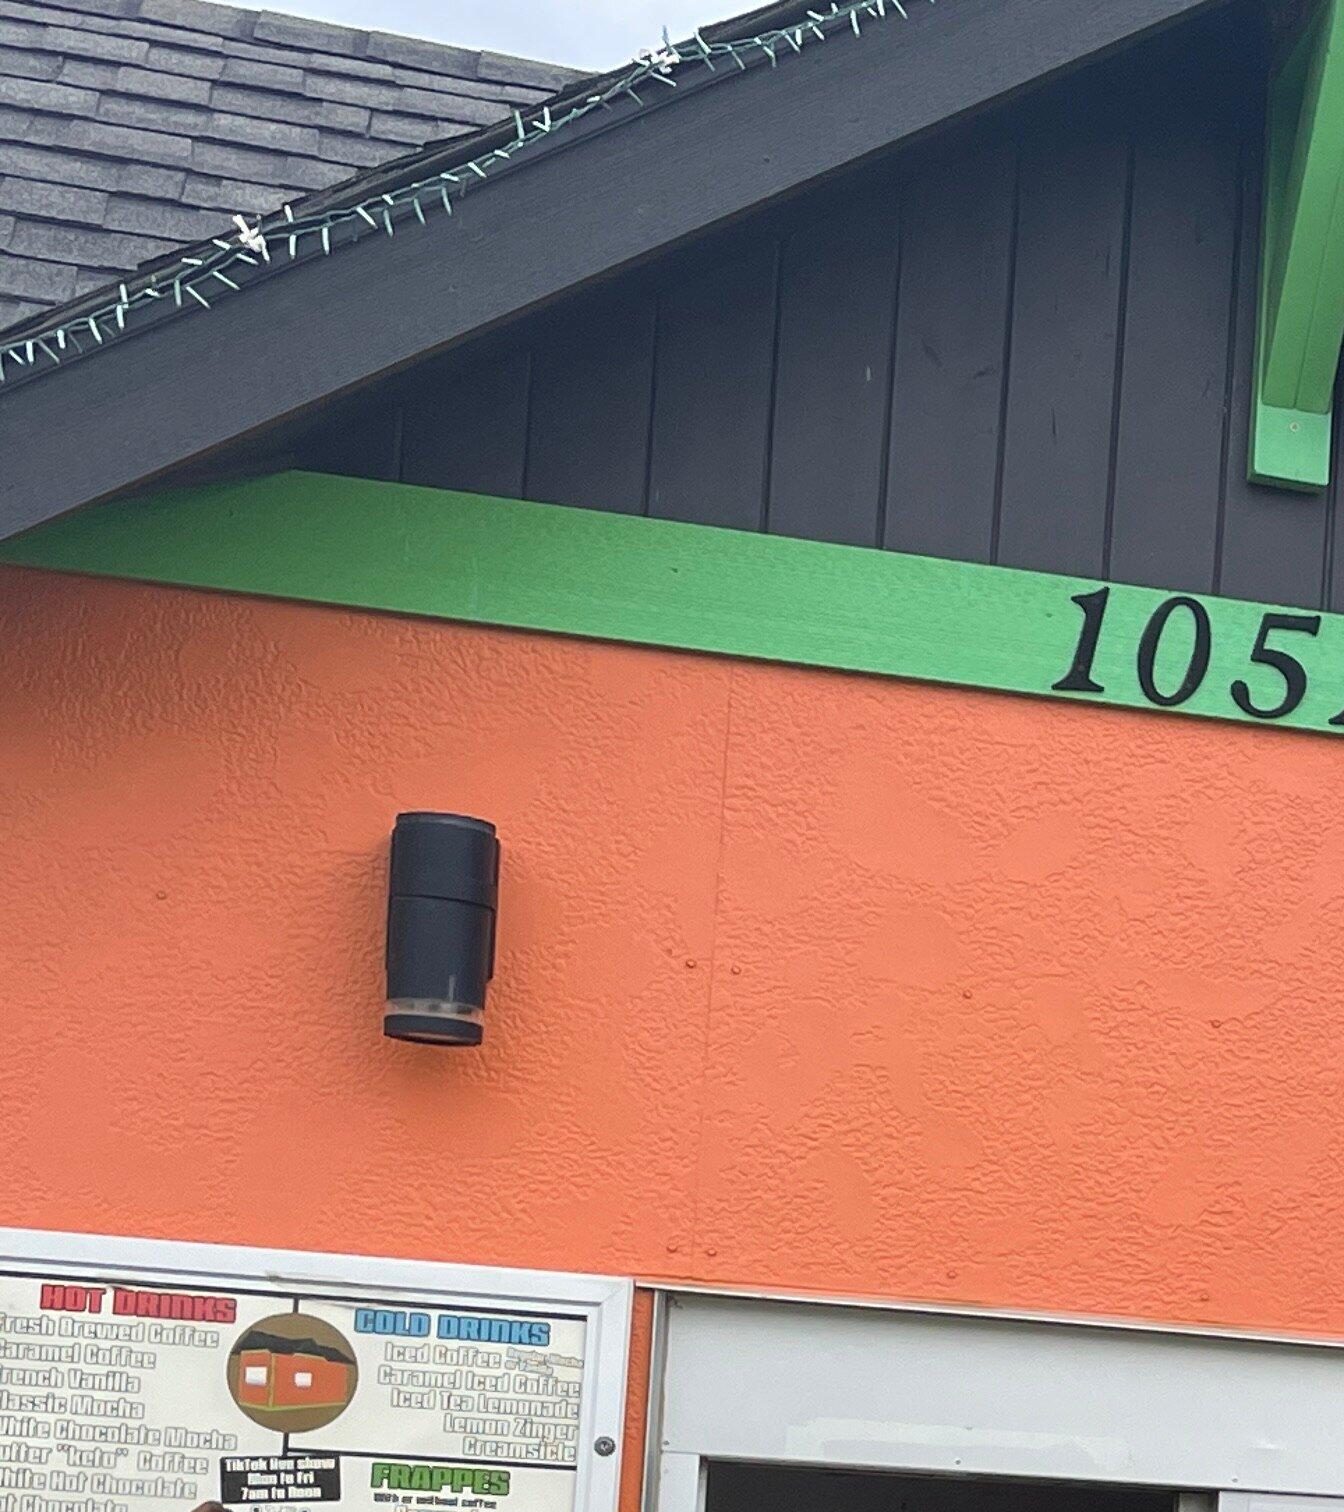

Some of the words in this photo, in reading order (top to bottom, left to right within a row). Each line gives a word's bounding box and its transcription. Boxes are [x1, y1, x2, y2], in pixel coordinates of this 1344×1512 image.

[40, 1284, 106, 1313] HOT
[113, 1287, 237, 1323] DRINKS
[59, 1317, 145, 1342] Brewed
[150, 1324, 219, 1348] Coffee
[354, 1308, 431, 1337] COLD
[437, 1314, 551, 1346] DRINKS
[84, 1345, 156, 1369] Coffee
[385, 1342, 429, 1364] Iced
[434, 1345, 502, 1368] Coffee
[0, 1366, 63, 1388] rench
[68, 1368, 141, 1393] Vanilla
[378, 1365, 461, 1390] Caramel
[465, 1370, 510, 1393] Iced
[513, 1374, 581, 1398] Coffee
[0, 1390, 67, 1413] lassic
[70, 1395, 145, 1419] Mocha
[390, 1388, 435, 1410] Iced
[439, 1390, 475, 1412] Tea
[477, 1393, 579, 1420] Lemonade
[55, 1420, 160, 1446] Chocolate
[164, 1427, 237, 1450] Mocha
[443, 1413, 510, 1437] Lemon
[513, 1418, 578, 1442] Zinger
[0, 1441, 50, 1464] utter
[137, 1452, 209, 1474] Coffee
[463, 1436, 577, 1462] Creamsicle
[0, 1467, 46, 1490] hite
[50, 1470, 88, 1492] Hot
[91, 1473, 197, 1499] Chocolate
[371, 1462, 511, 1496] FRAPPES
